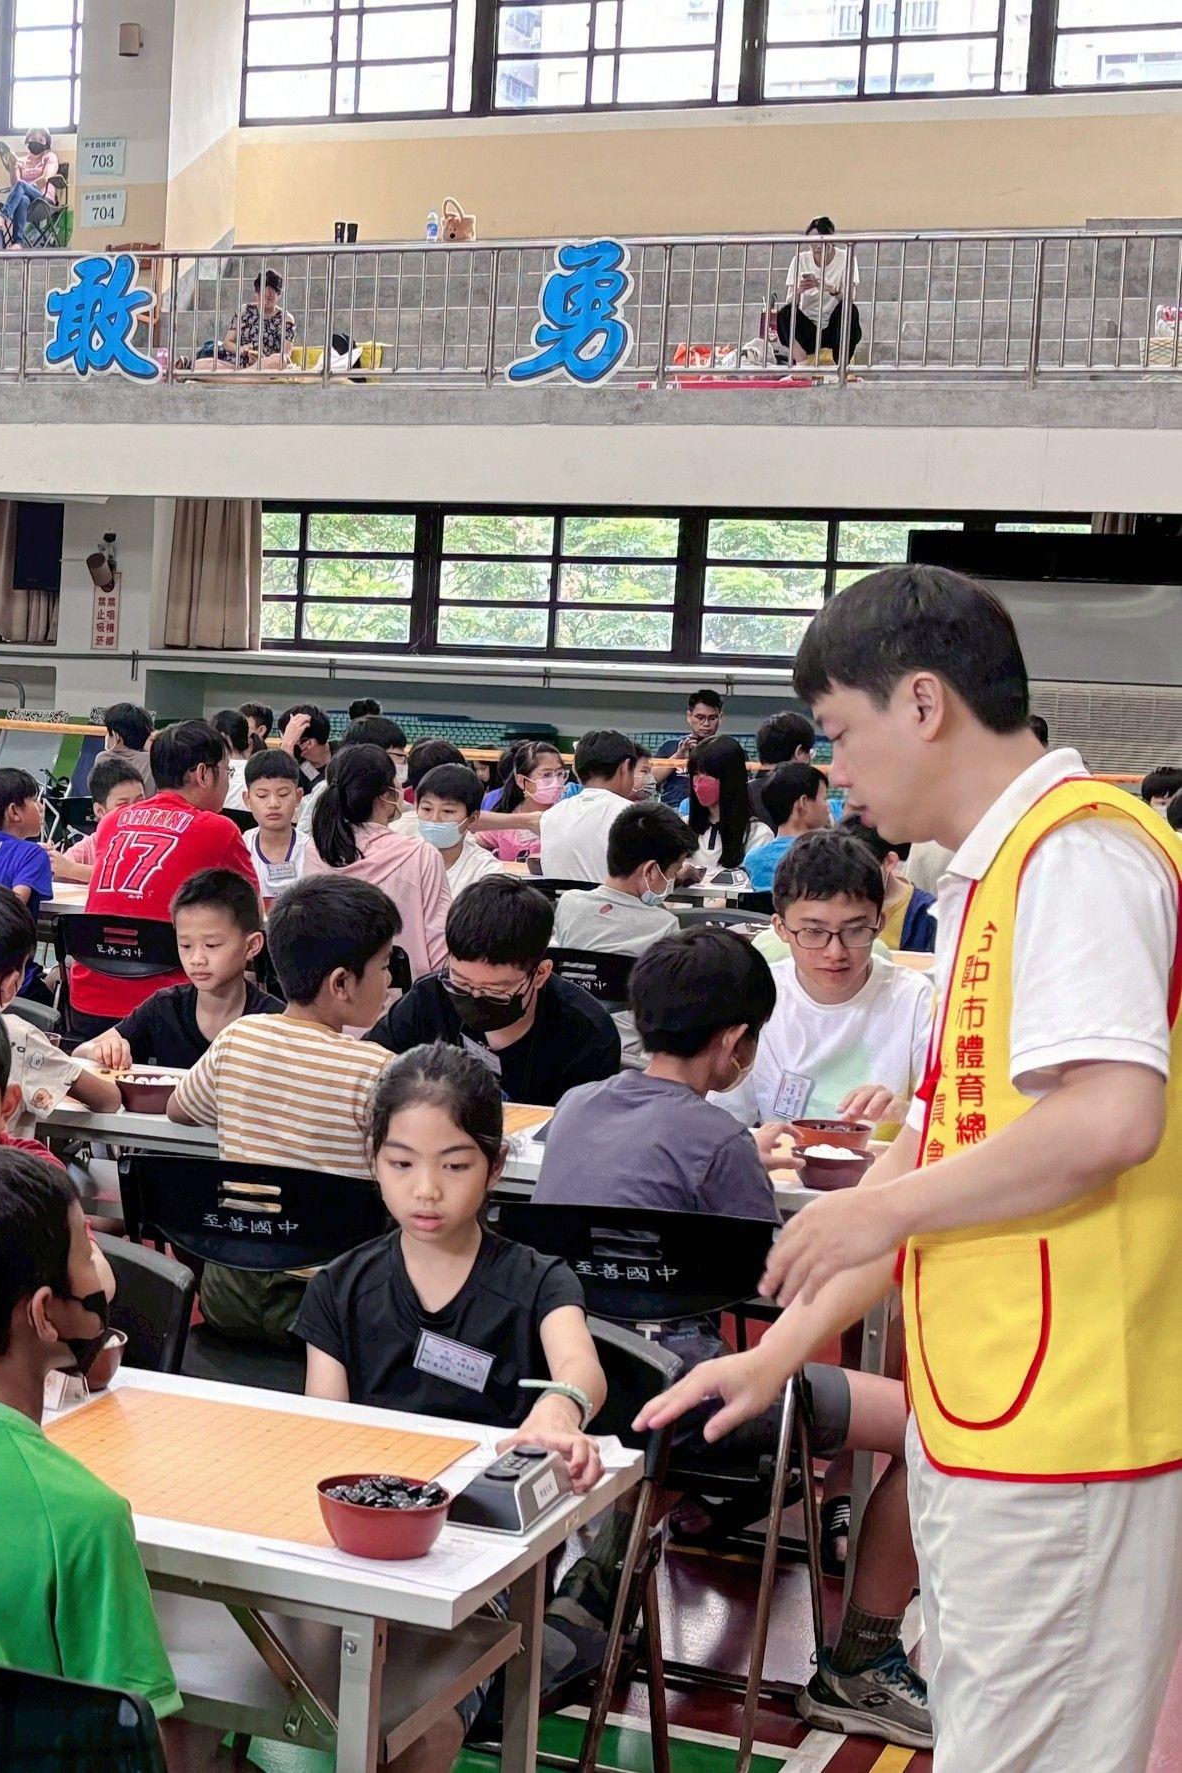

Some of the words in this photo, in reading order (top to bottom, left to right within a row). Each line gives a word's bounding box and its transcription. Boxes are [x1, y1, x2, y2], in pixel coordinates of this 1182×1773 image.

[91, 154, 114, 168] 703
[92, 206, 115, 221] 704
[45, 254, 160, 382] 敢
[506, 239, 631, 386] 勇
[117, 808, 194, 833] OHTANI
[96, 831, 179, 895] 17
[202, 1213, 299, 1236] 至善國中
[575, 1260, 679, 1282] 至善國中
